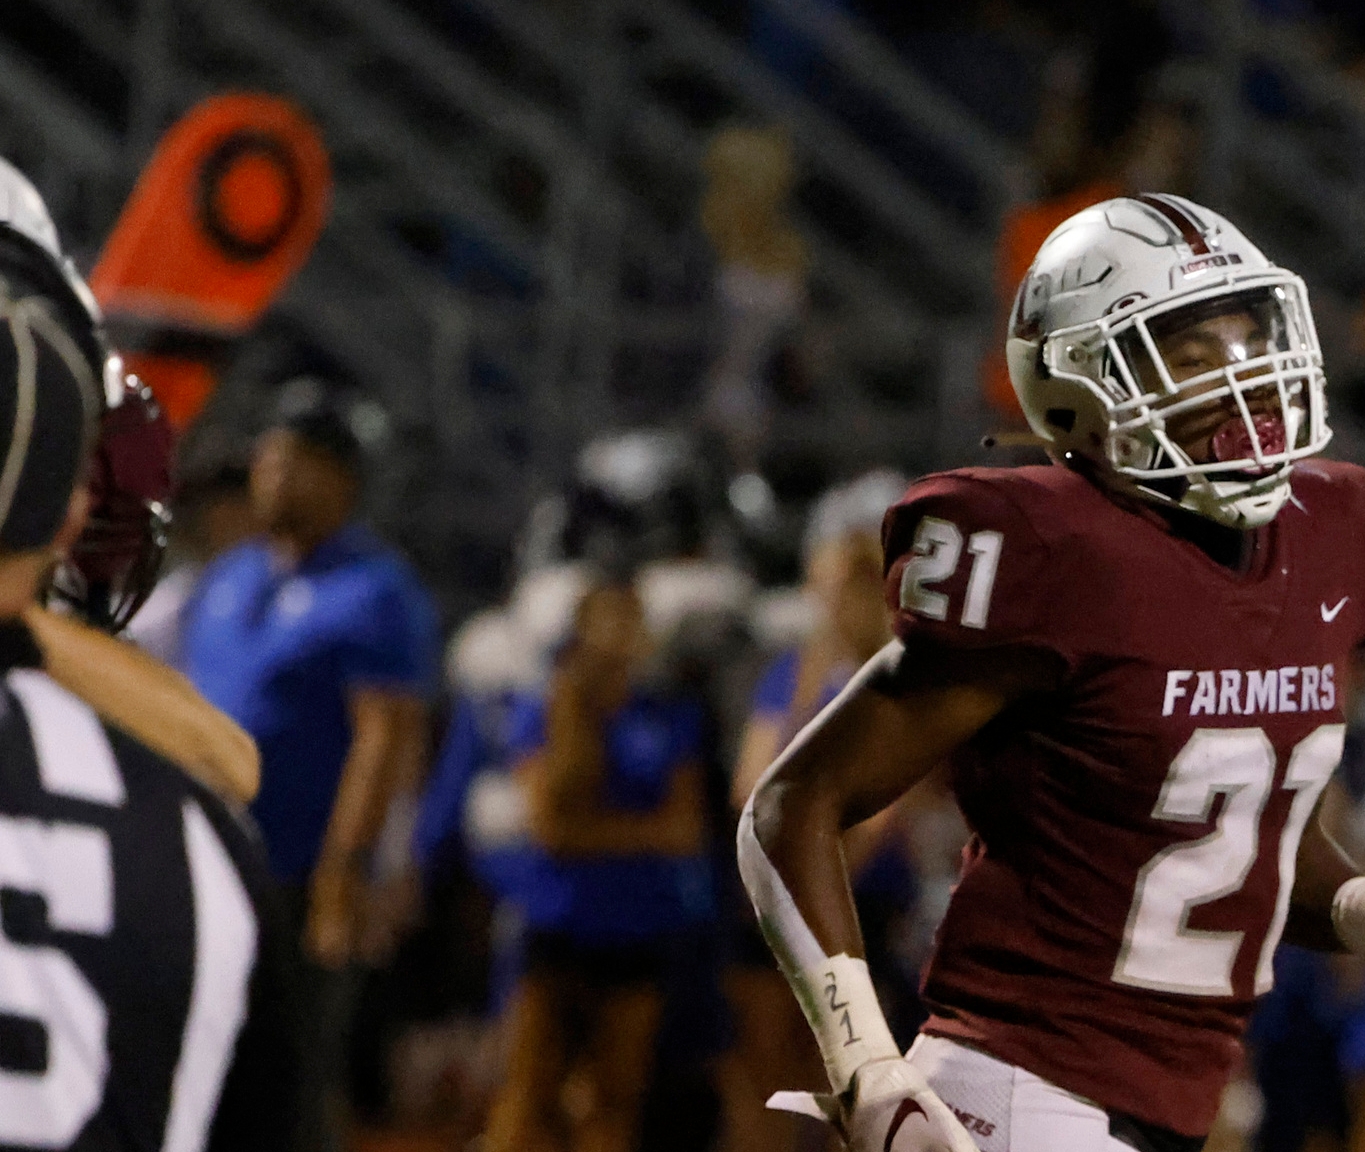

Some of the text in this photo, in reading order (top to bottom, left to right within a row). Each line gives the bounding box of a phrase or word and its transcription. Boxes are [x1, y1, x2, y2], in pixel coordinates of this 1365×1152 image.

[900, 515, 1004, 629] 21
[1162, 664, 1336, 717] FARMERS
[1110, 723, 1347, 997] 21
